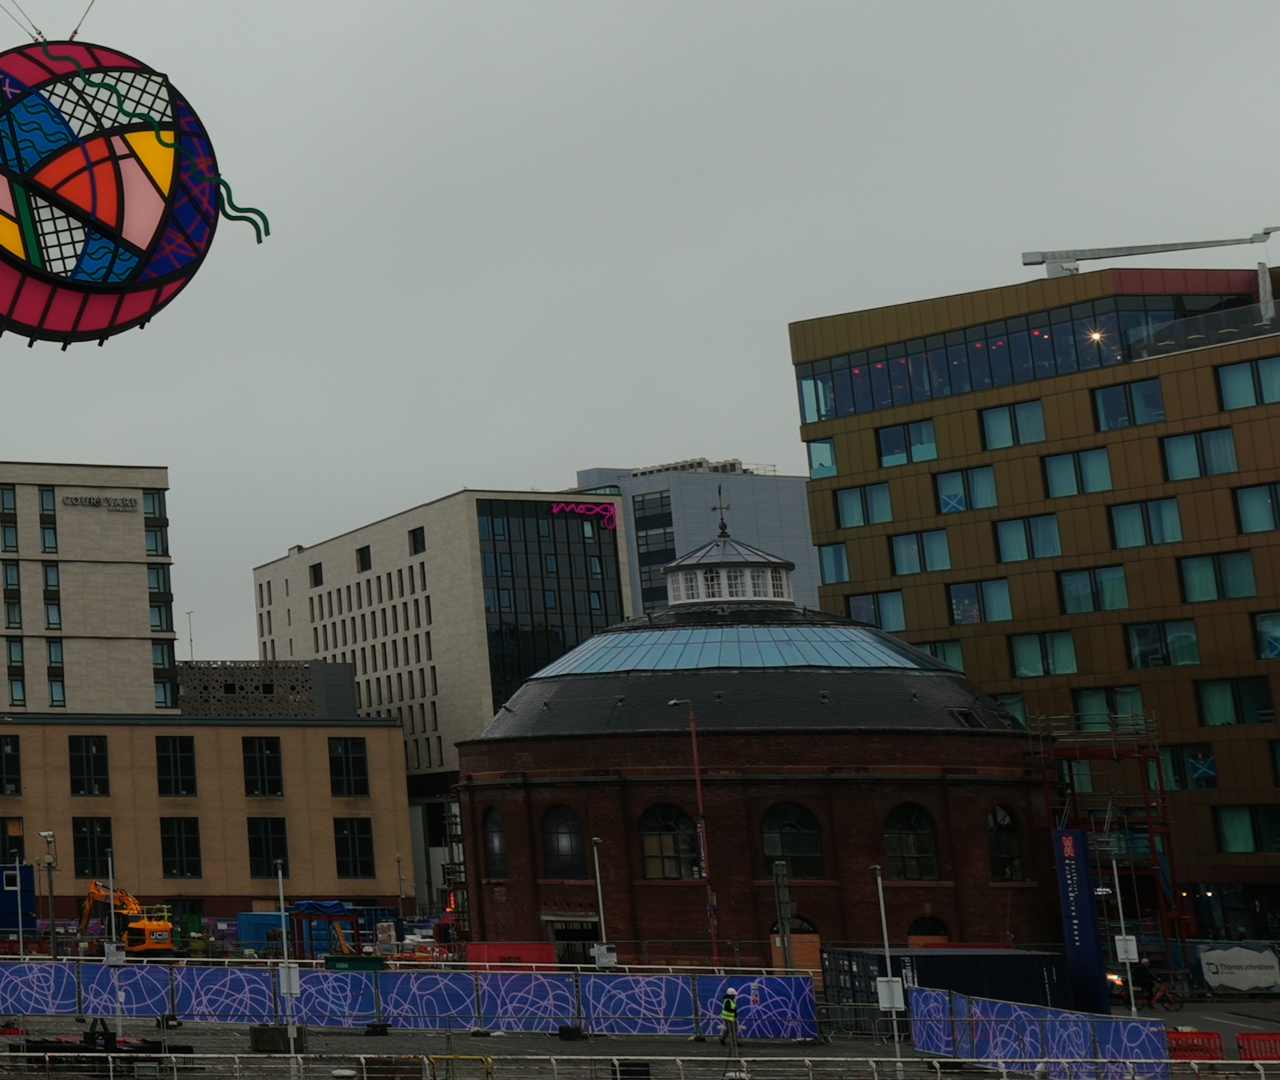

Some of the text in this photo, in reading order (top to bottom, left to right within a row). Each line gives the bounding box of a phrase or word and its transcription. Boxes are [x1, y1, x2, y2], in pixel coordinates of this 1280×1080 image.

[551, 502, 616, 530] moxy
[150, 931, 169, 939] JCB
[1219, 963, 1244, 971] Thomas
